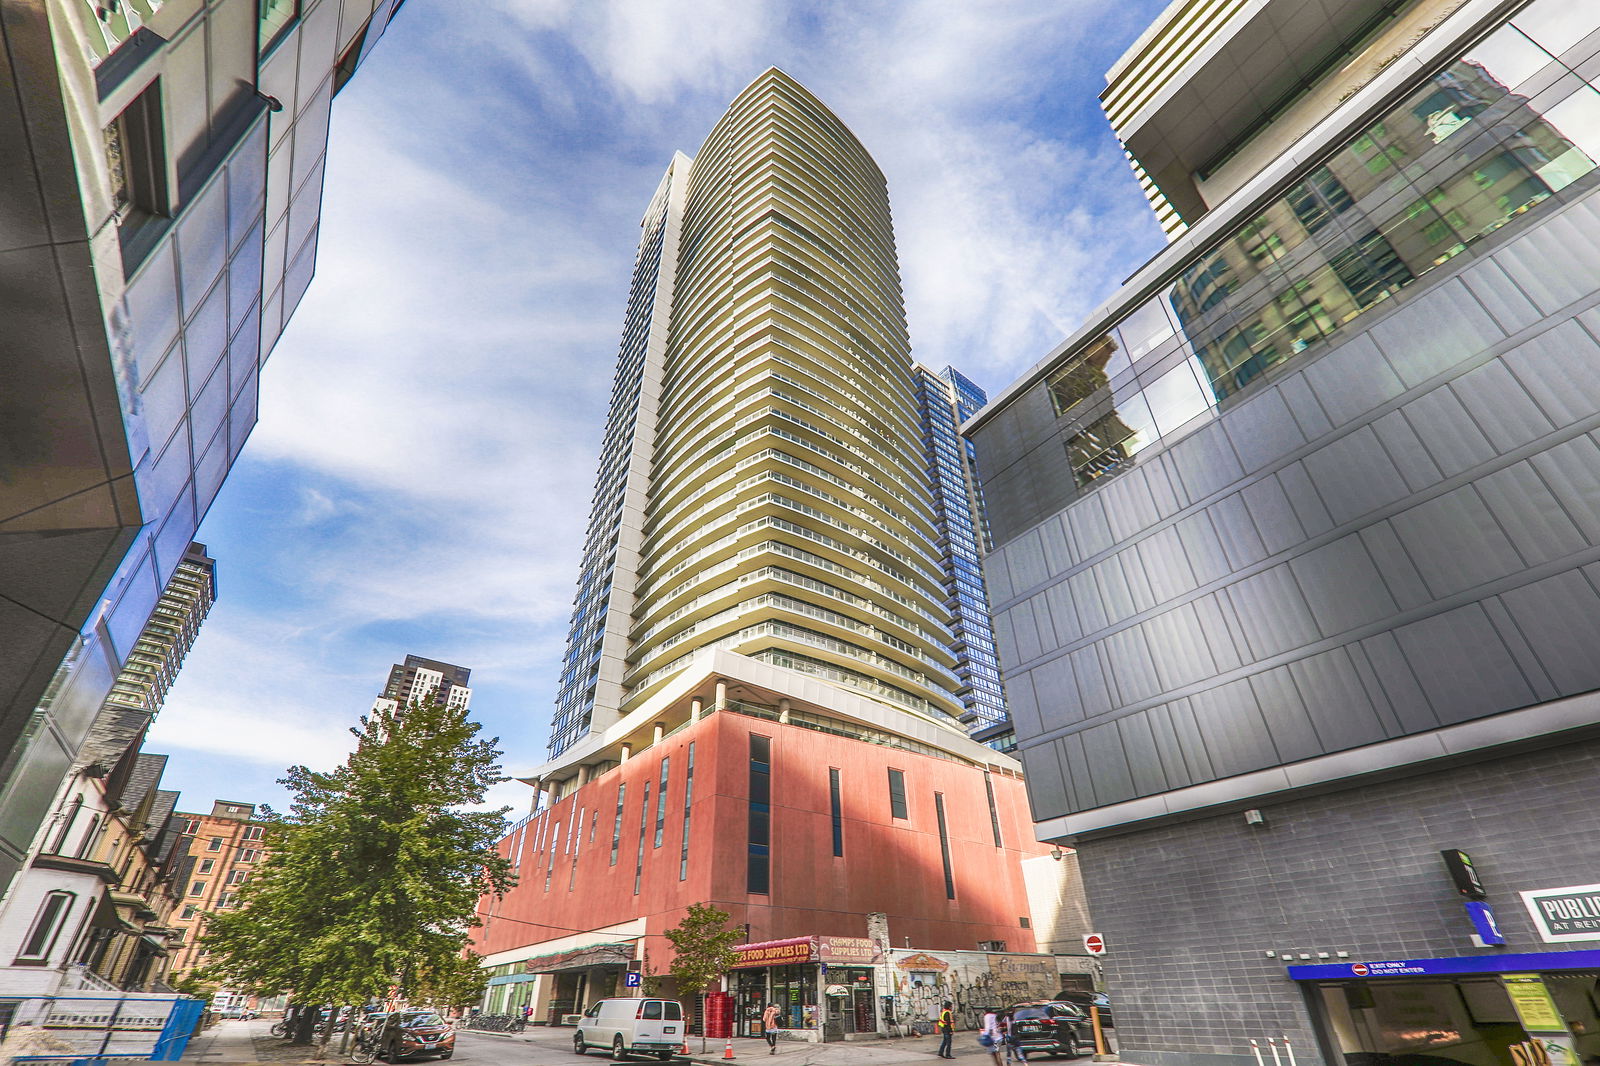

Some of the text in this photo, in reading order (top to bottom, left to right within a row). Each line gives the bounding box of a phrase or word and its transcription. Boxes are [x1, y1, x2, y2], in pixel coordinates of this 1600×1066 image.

[1483, 910, 1502, 937] P
[1553, 922, 1569, 930] AT
[830, 938, 873, 948] CHAMPS FOOD
[748, 949, 764, 960] FOOD
[765, 945, 794, 959] SUPPLIES
[831, 947, 860, 956] SUPPLIES
[628, 974, 637, 985] P
